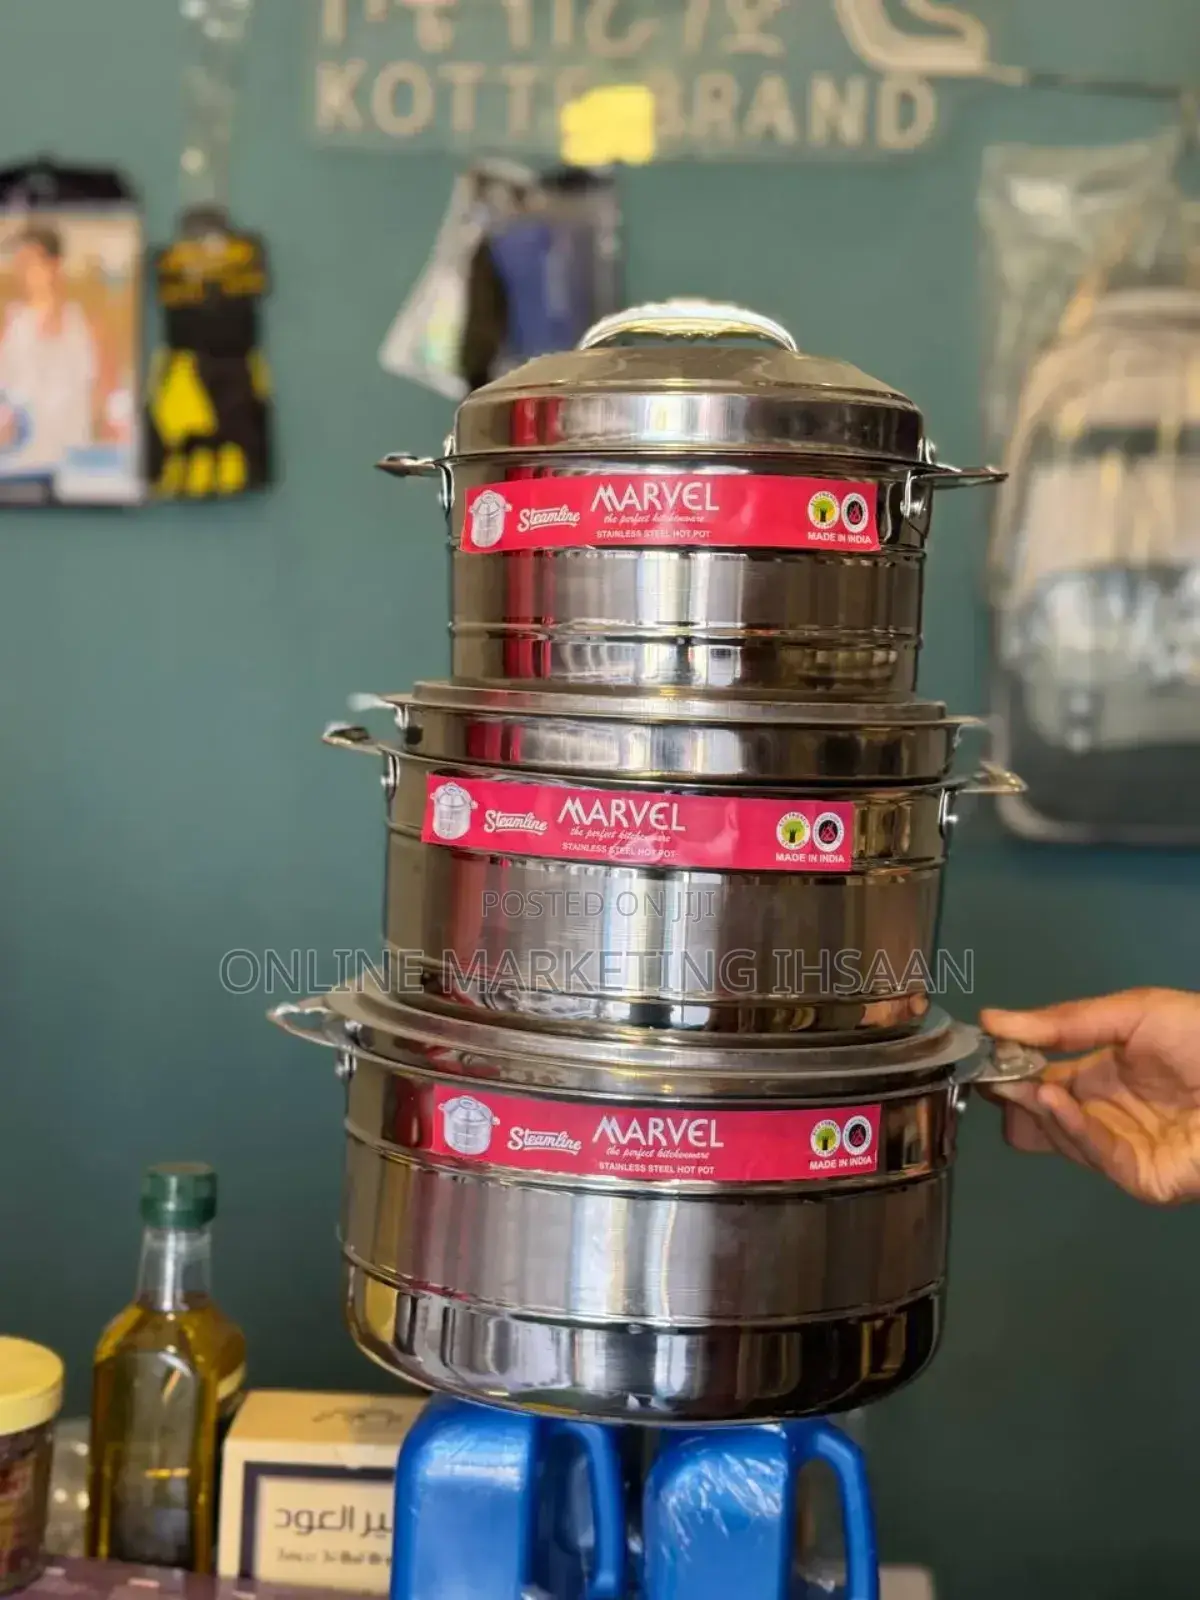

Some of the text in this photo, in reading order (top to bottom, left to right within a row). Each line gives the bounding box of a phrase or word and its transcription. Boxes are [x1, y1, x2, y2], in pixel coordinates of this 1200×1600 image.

[590, 481, 720, 513] MARVEL
[517, 504, 581, 533] Steamline
[596, 529, 711, 539] STAINLESS STEEL HOT POT
[807, 531, 872, 544] MADE IN INDIA
[483, 809, 549, 836] Steamline
[557, 796, 686, 832] MARVEL
[562, 842, 607, 853] STAINLESS
[638, 849, 655, 857] HOT
[775, 853, 845, 863] MADE IN INDIA
[507, 1127, 582, 1155] Steamline
[592, 1115, 724, 1148] MARVEL
[600, 1162, 715, 1175] STAINLESS STEEL HOT POT
[809, 1156, 872, 1171] MADE IN INDIA
